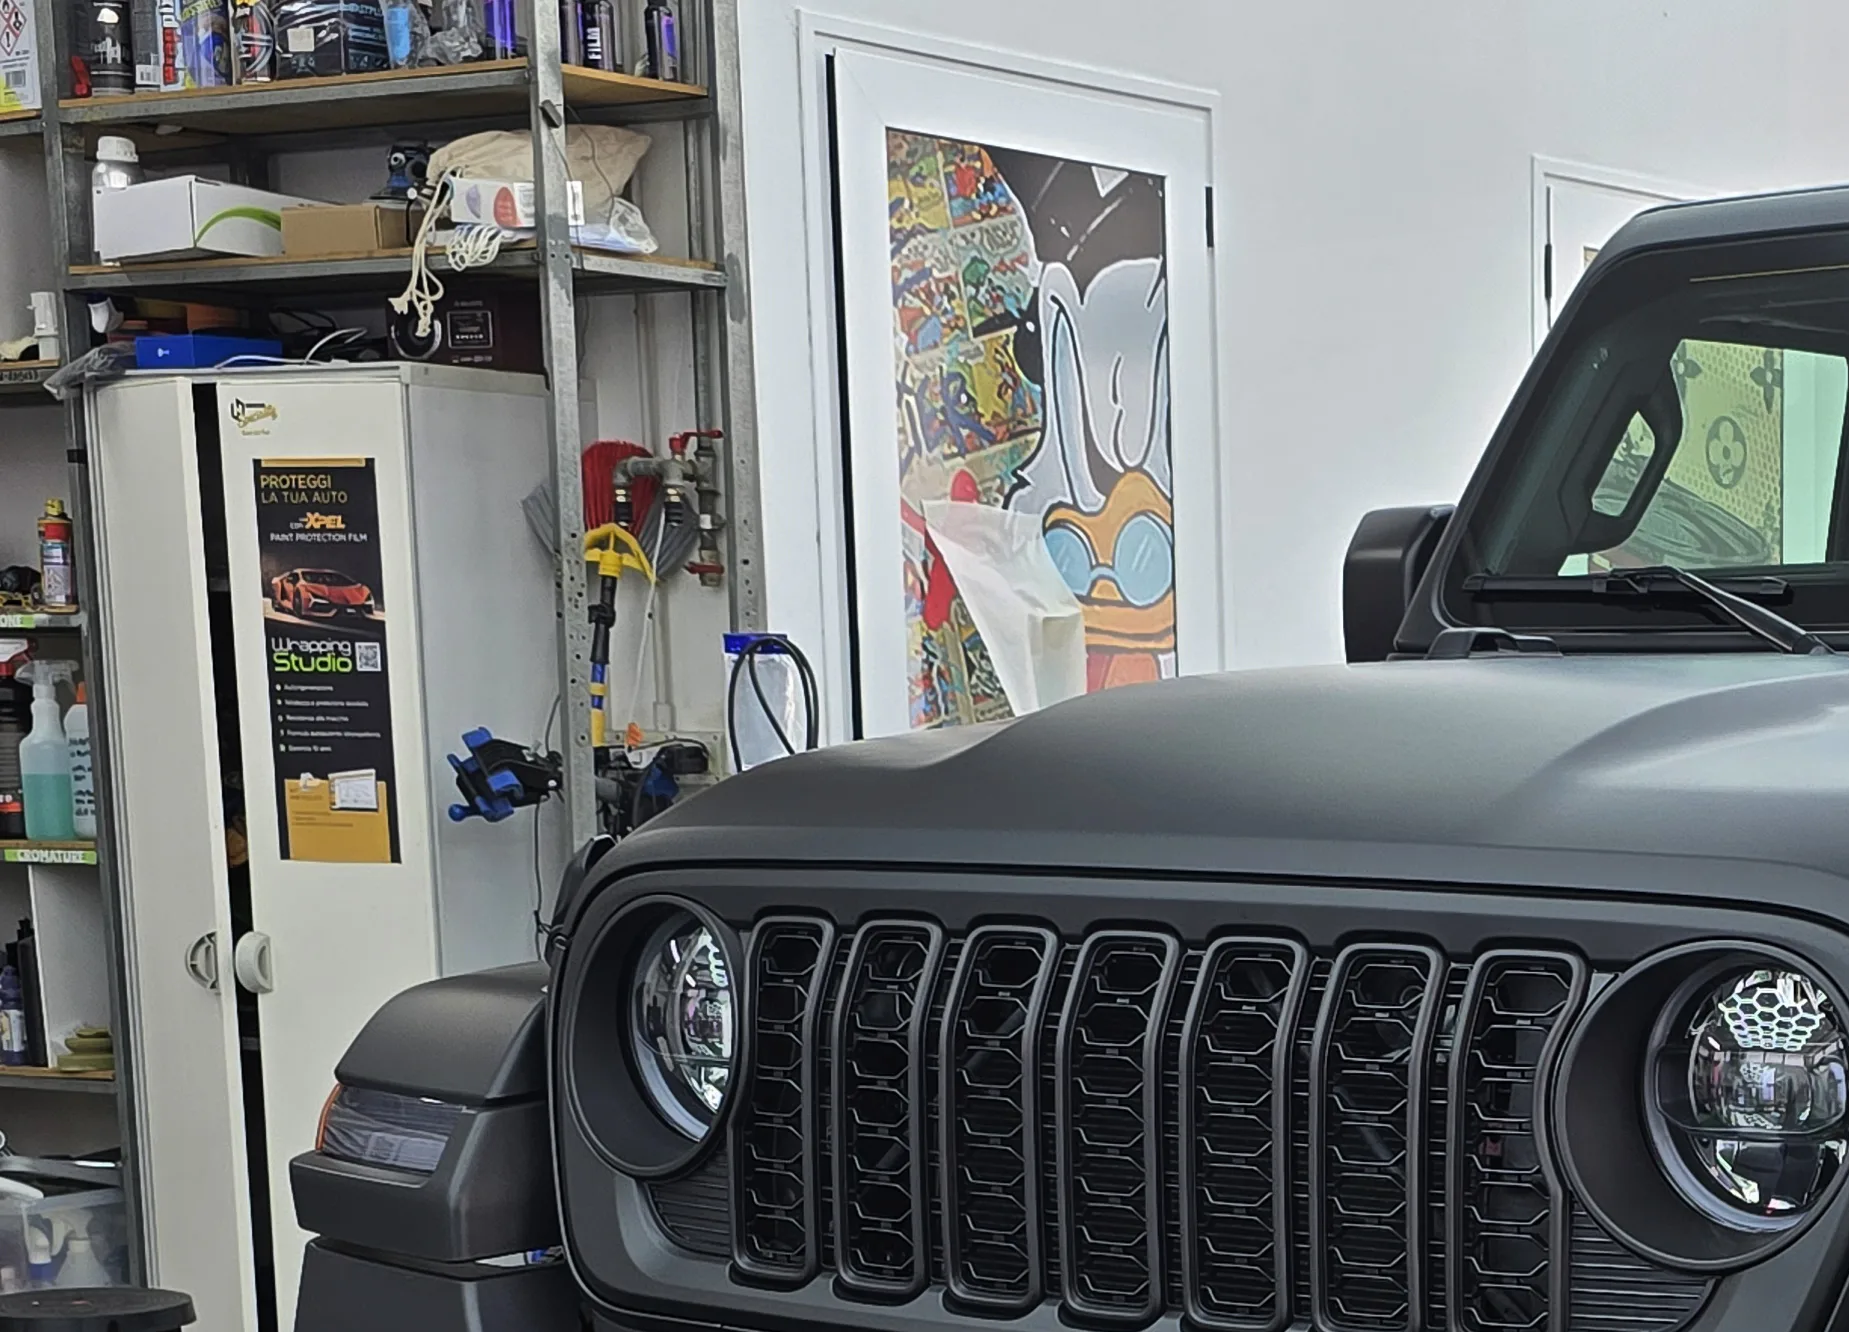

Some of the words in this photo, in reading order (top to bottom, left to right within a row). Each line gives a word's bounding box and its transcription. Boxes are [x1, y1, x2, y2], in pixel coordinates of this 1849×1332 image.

[586, 27, 602, 60] FILM
[260, 474, 332, 489] PROTEGGI
[261, 491, 278, 503] LA
[282, 491, 308, 503] TUA
[312, 491, 348, 503] AUTO
[302, 512, 346, 529] XPEL
[269, 532, 294, 542] PAINT
[295, 532, 347, 542] PROTECTION
[348, 532, 368, 542] FILM
[271, 636, 352, 655] Wrapping
[273, 652, 353, 673] Studio
